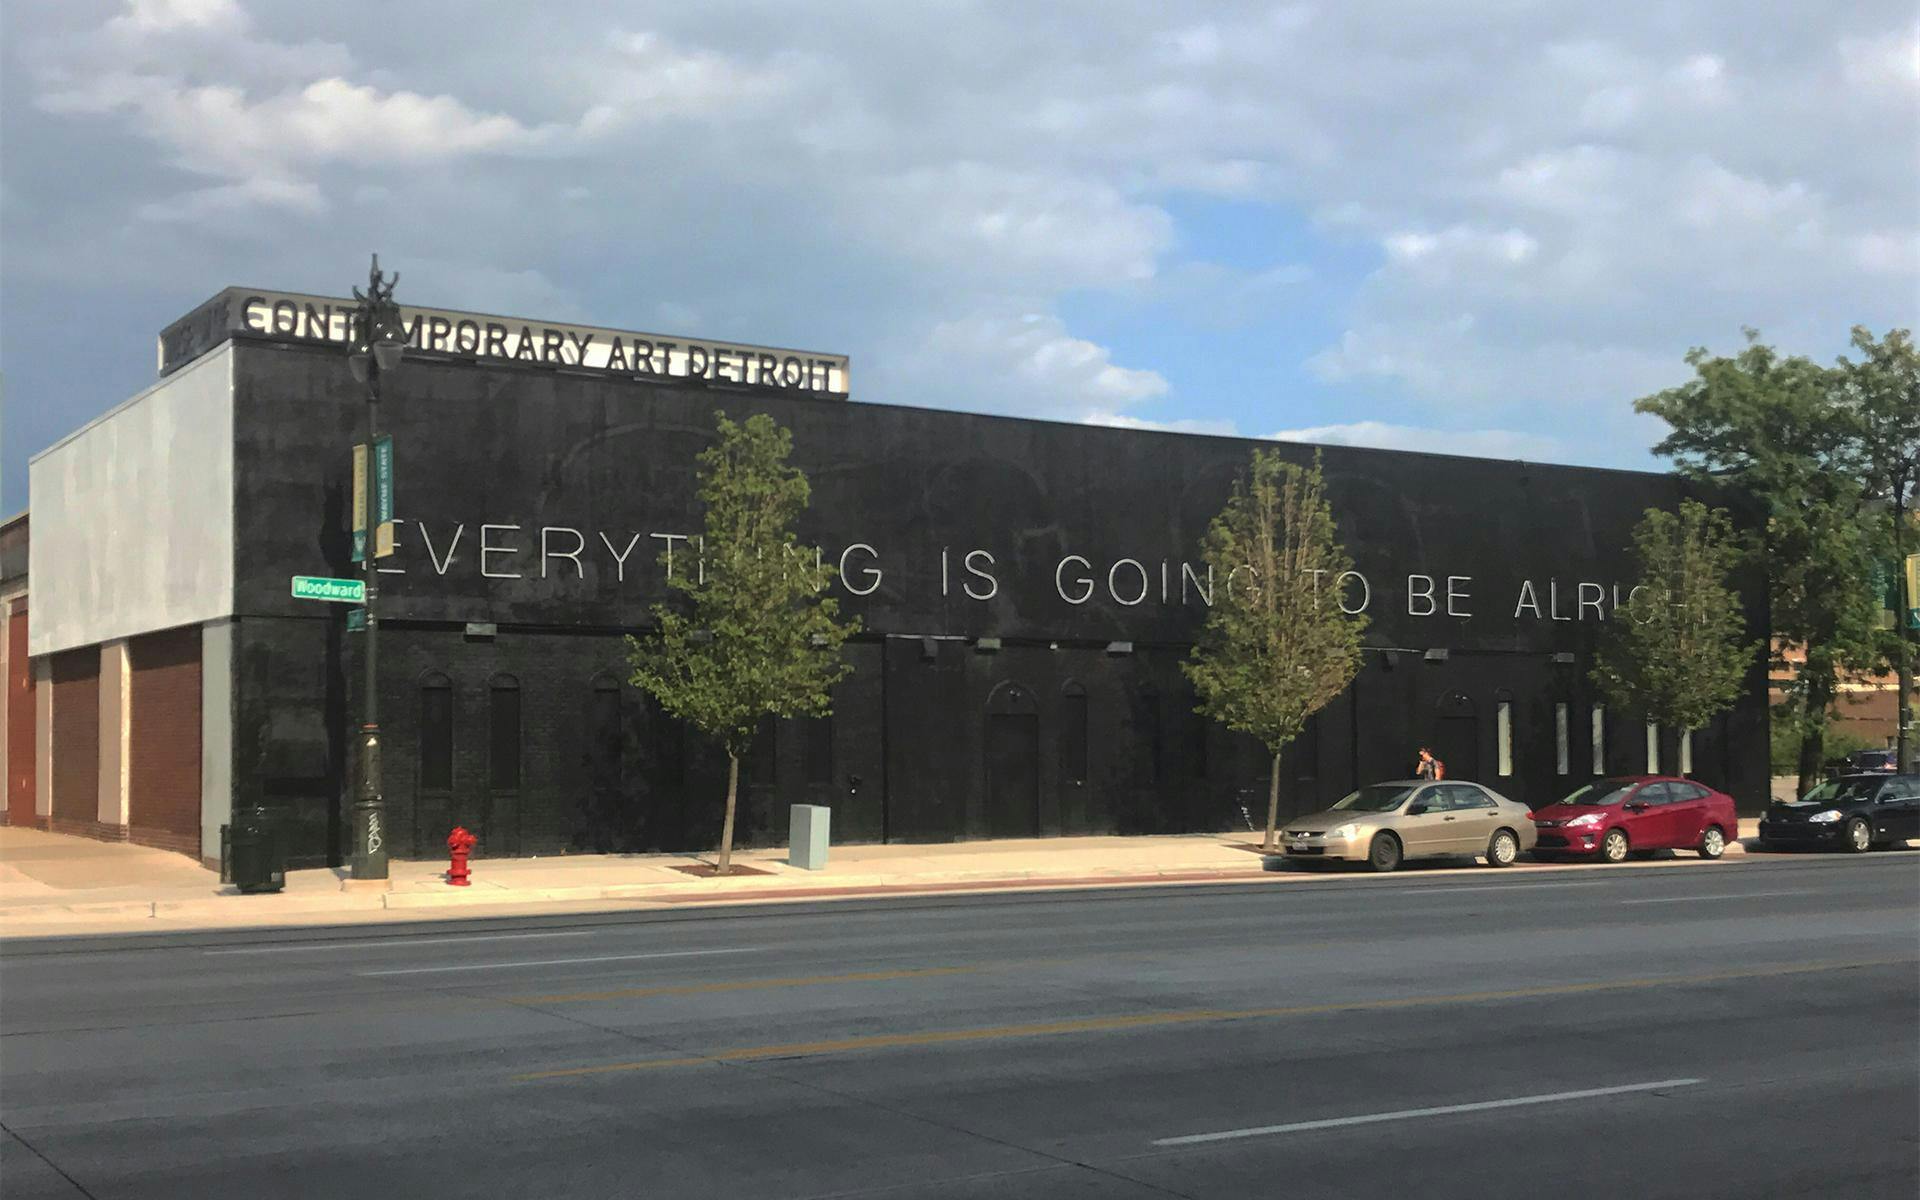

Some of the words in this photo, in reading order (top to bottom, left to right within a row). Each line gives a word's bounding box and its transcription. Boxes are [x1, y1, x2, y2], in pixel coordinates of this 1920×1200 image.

[241, 296, 594, 366] CONTMPORARY
[606, 336, 678, 376] ART
[688, 345, 837, 391] DETROIT
[297, 580, 362, 598] Woodward
[942, 550, 998, 600] IS
[1055, 555, 1261, 608] GOING
[1301, 569, 1371, 614] TO
[1408, 574, 1473, 617] BE
